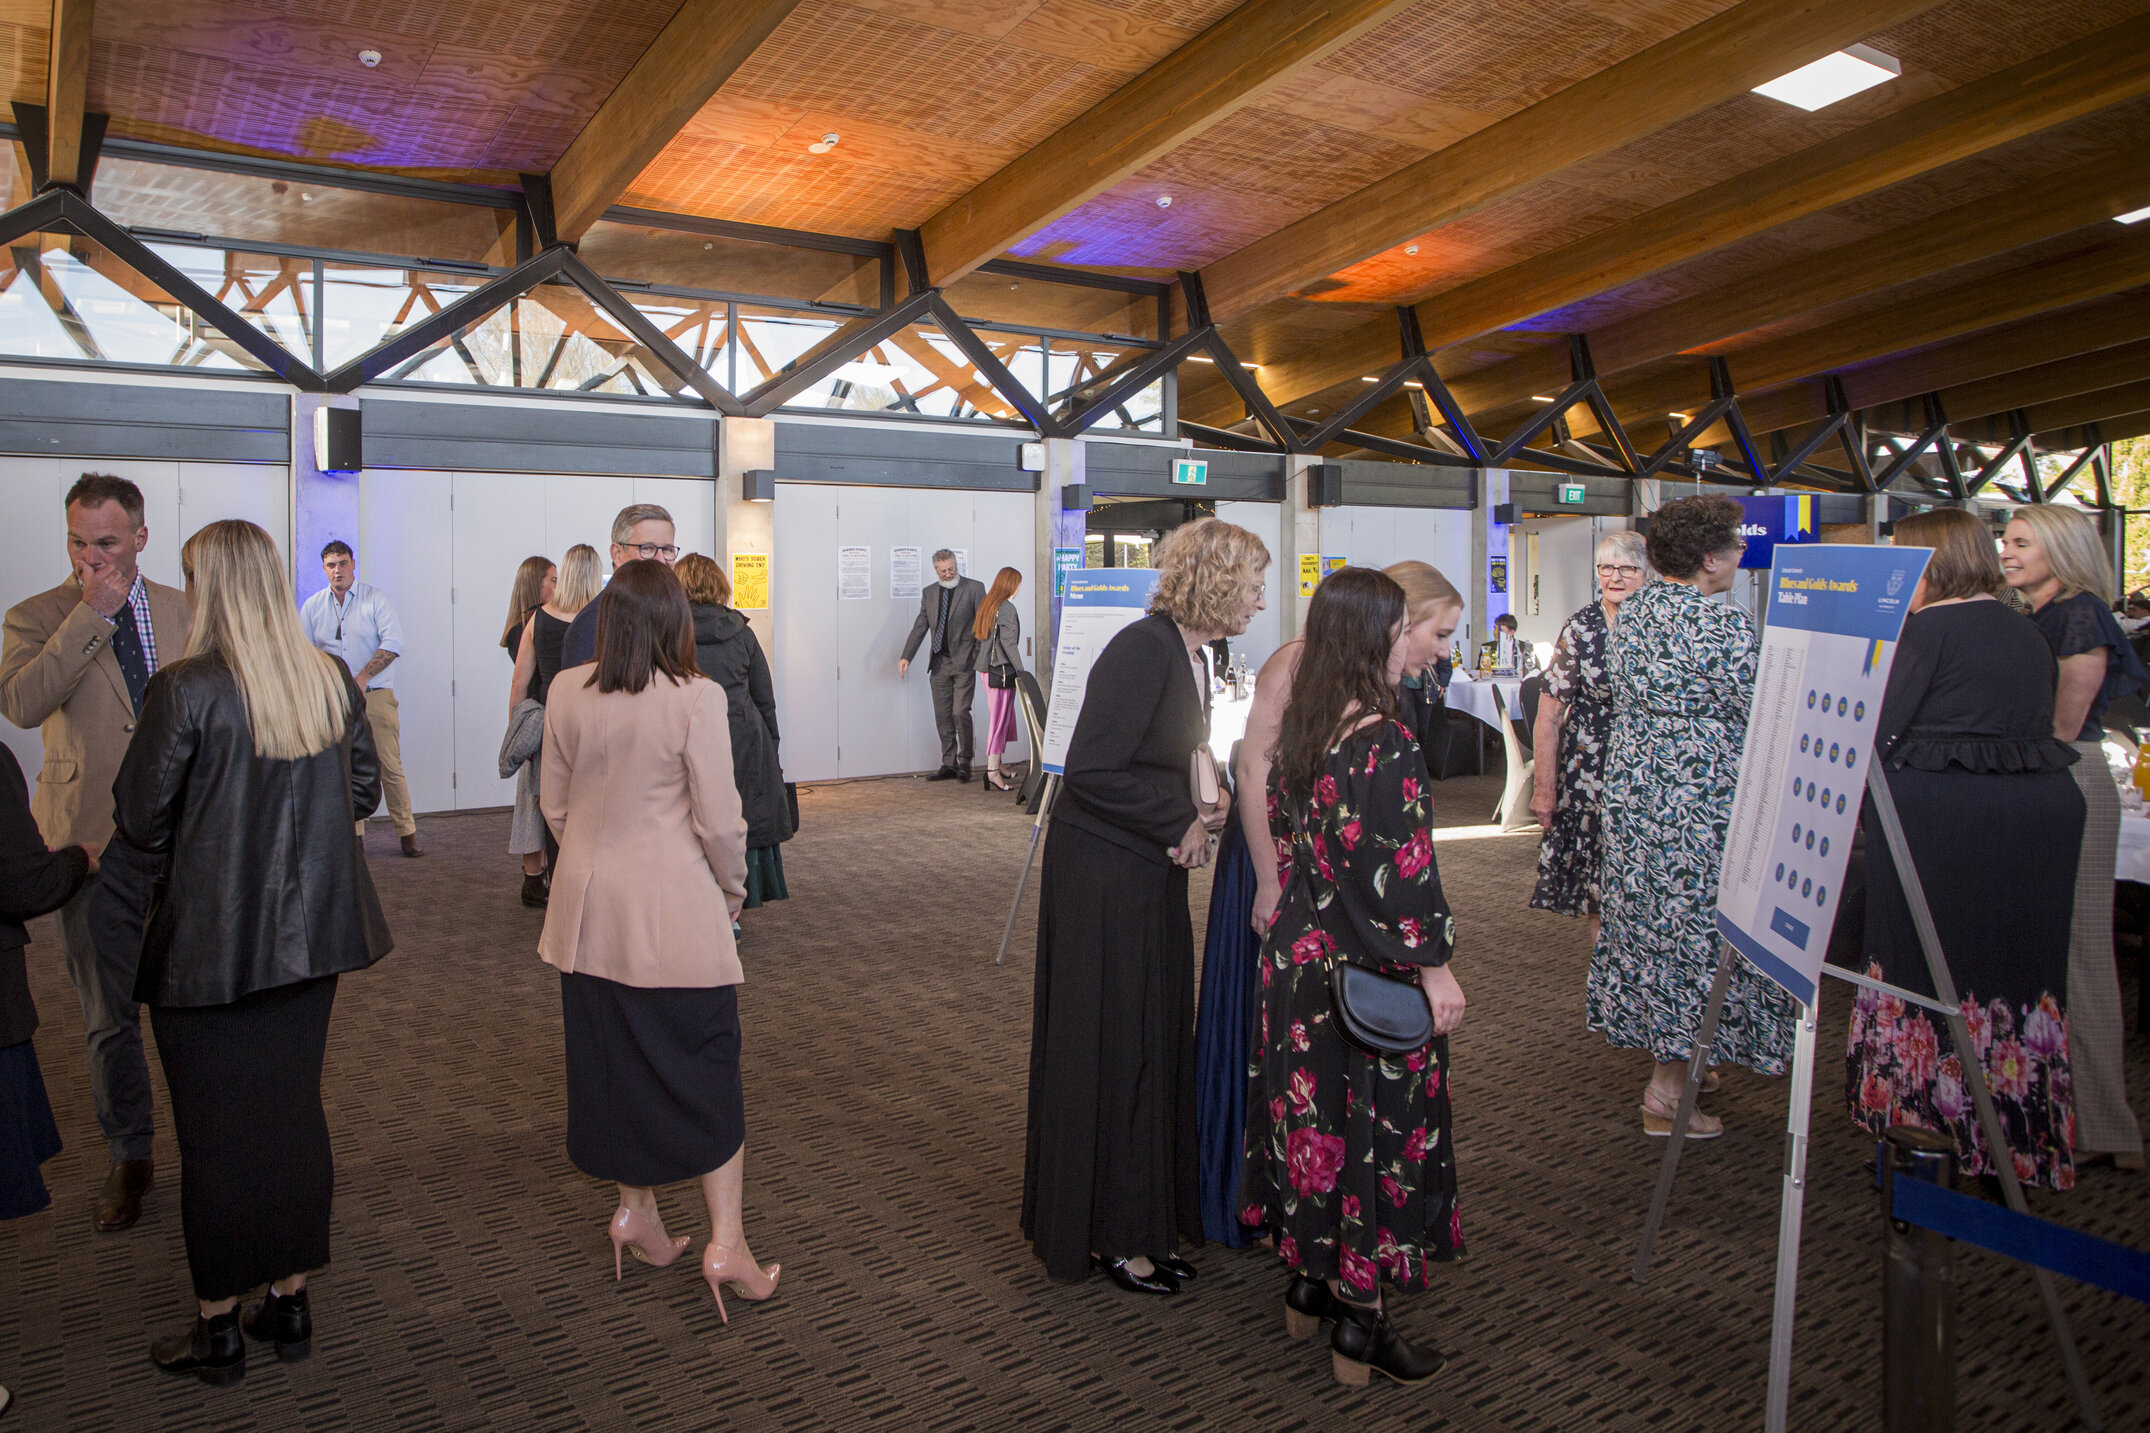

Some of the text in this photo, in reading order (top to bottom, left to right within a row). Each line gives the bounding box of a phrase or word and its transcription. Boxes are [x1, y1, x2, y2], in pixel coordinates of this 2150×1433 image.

[1569, 490, 1581, 501] EXIT
[1109, 584, 1130, 592] Awards
[1779, 577, 1859, 592] Blues and Golds Awards
[1778, 591, 1808, 605] Table Plan
